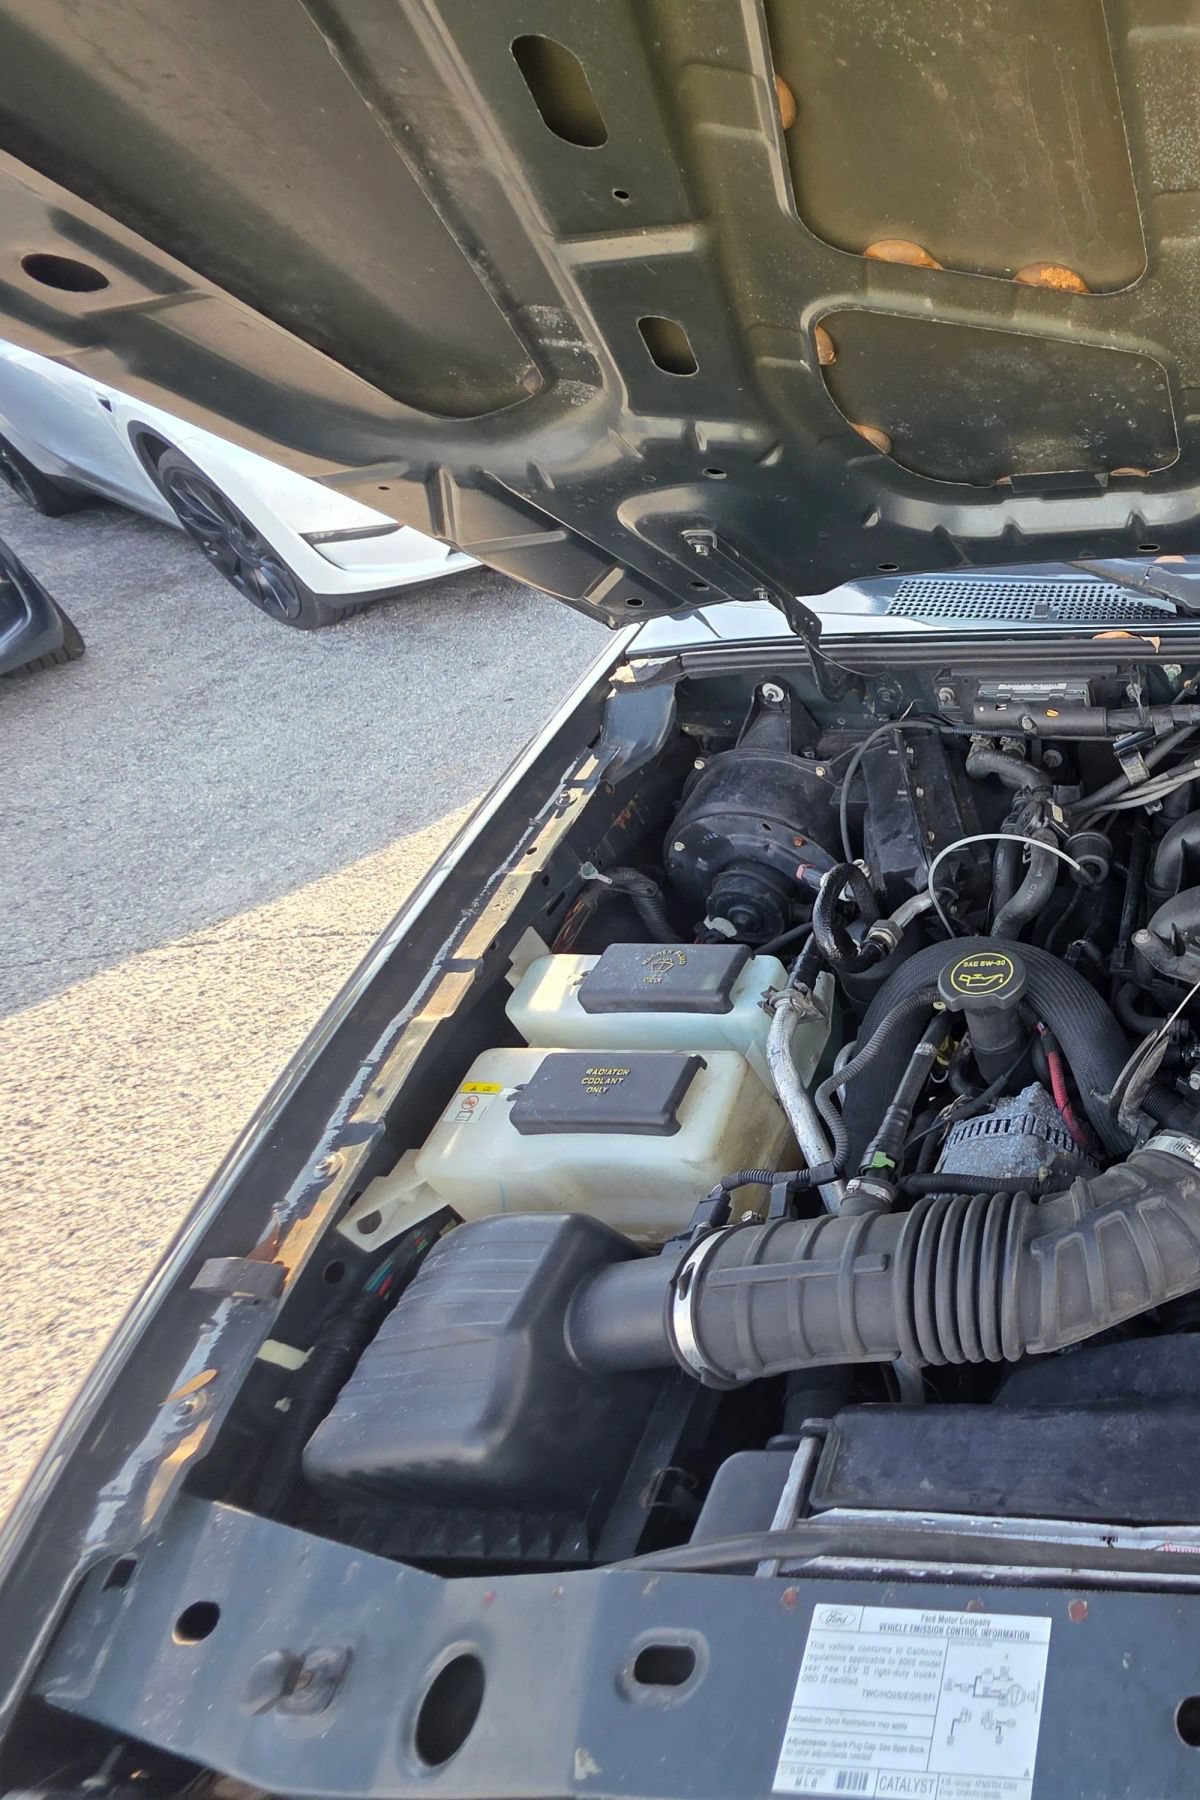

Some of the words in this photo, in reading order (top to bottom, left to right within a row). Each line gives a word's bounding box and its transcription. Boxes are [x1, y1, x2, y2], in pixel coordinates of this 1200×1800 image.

[962, 960, 979, 968] SAE
[979, 959, 1006, 968] 5W-30
[585, 1067, 630, 1077] RADIATOR
[581, 1077, 624, 1086] COOLANT
[586, 1086, 609, 1095] ONLY
[920, 1614, 936, 1623] Ford
[938, 1615, 957, 1625] Motor
[959, 1616, 991, 1627] Company
[879, 1623, 907, 1633] VEHICLE
[909, 1624, 944, 1635] EMISSION
[946, 1626, 978, 1637] CONTROL
[981, 1628, 1031, 1640] INFORMATION
[810, 1641, 825, 1650] This
[829, 1642, 854, 1652] vehicle
[858, 1644, 892, 1655] conforms
[895, 1646, 904, 1654] to
[906, 1646, 943, 1657] California
[806, 1653, 846, 1663] regulations
[848, 1655, 885, 1666] applicable
[842, 1665, 858, 1674] LEV
[802, 1675, 818, 1684] OBD
[879, 1774, 936, 1795] CATALYST
